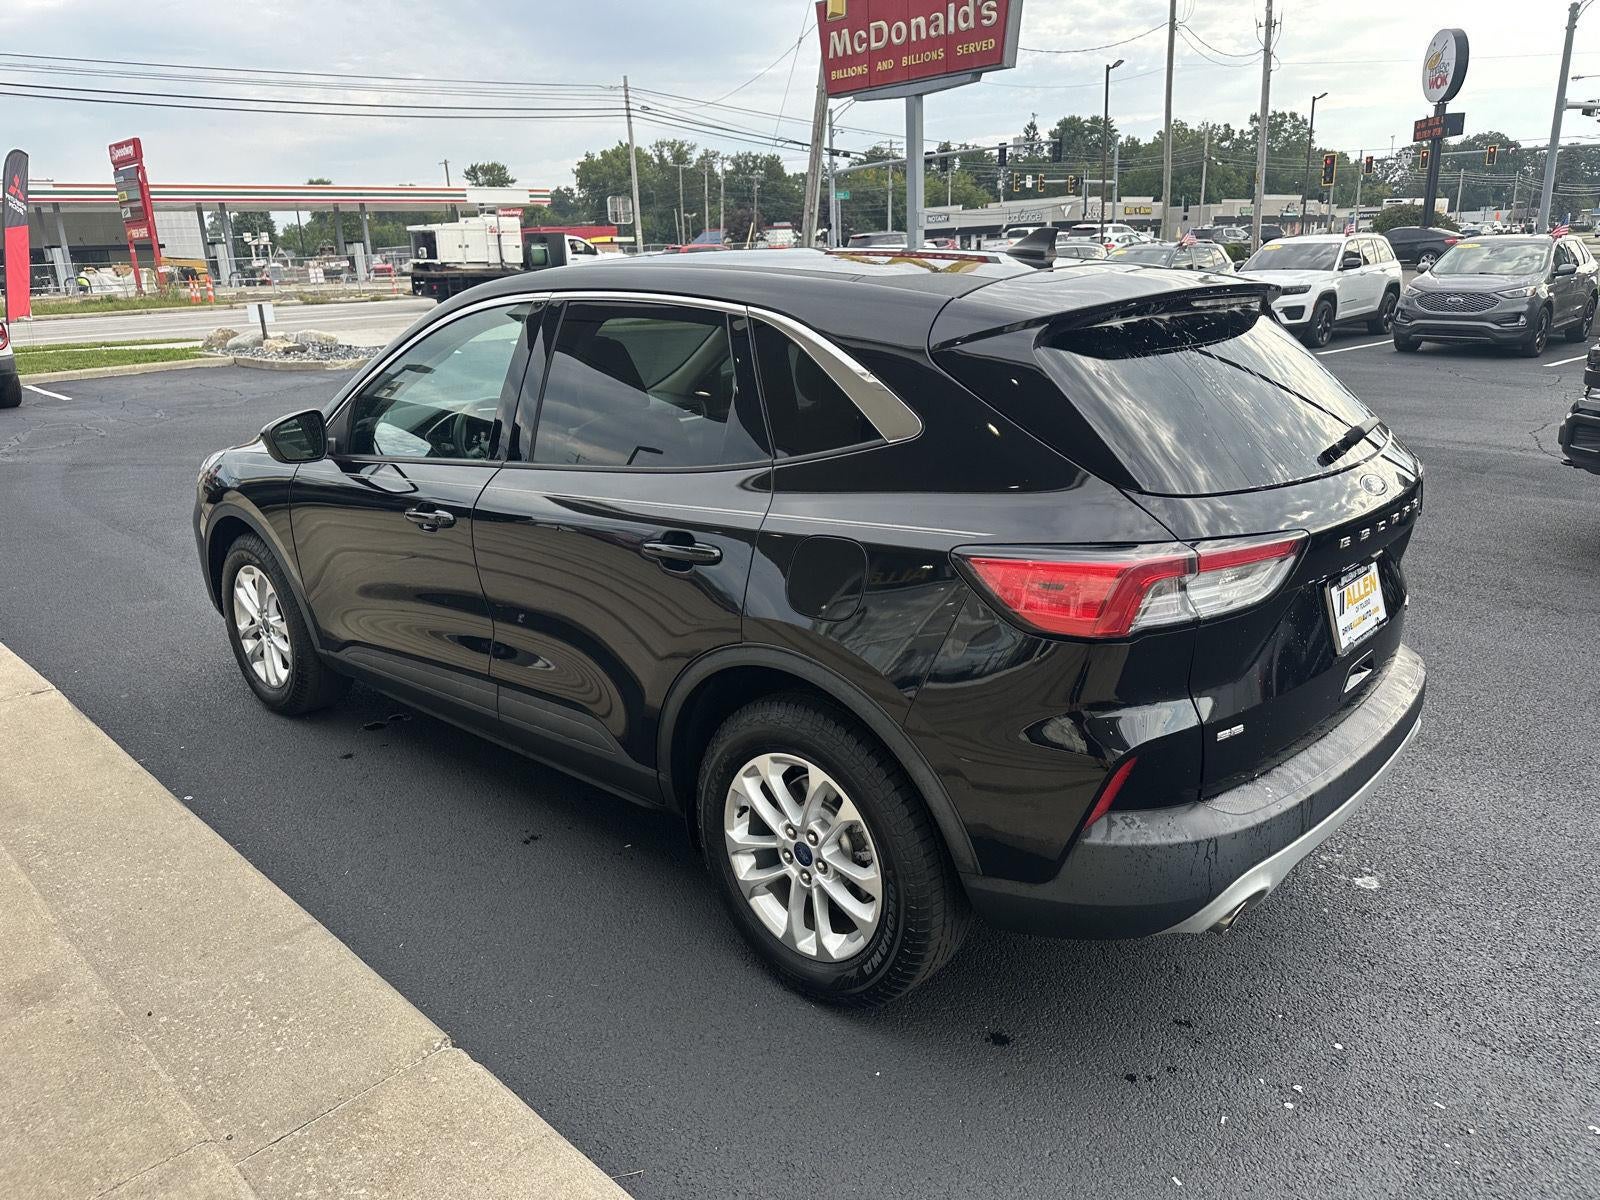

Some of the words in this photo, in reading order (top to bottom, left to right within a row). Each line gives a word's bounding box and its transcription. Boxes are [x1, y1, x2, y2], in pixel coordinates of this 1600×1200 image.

[828, 0, 998, 60] McDonald's
[831, 64, 868, 80] BILLIONS
[876, 59, 894, 72] AND
[901, 49, 945, 67] BILLIONS
[956, 38, 996, 57] SERVED
[1428, 73, 1449, 90] WOK
[110, 144, 134, 160] Speedway
[927, 215, 949, 224] NOTARY
[1007, 207, 1042, 223] balance
[1346, 571, 1378, 610] ALLEN
